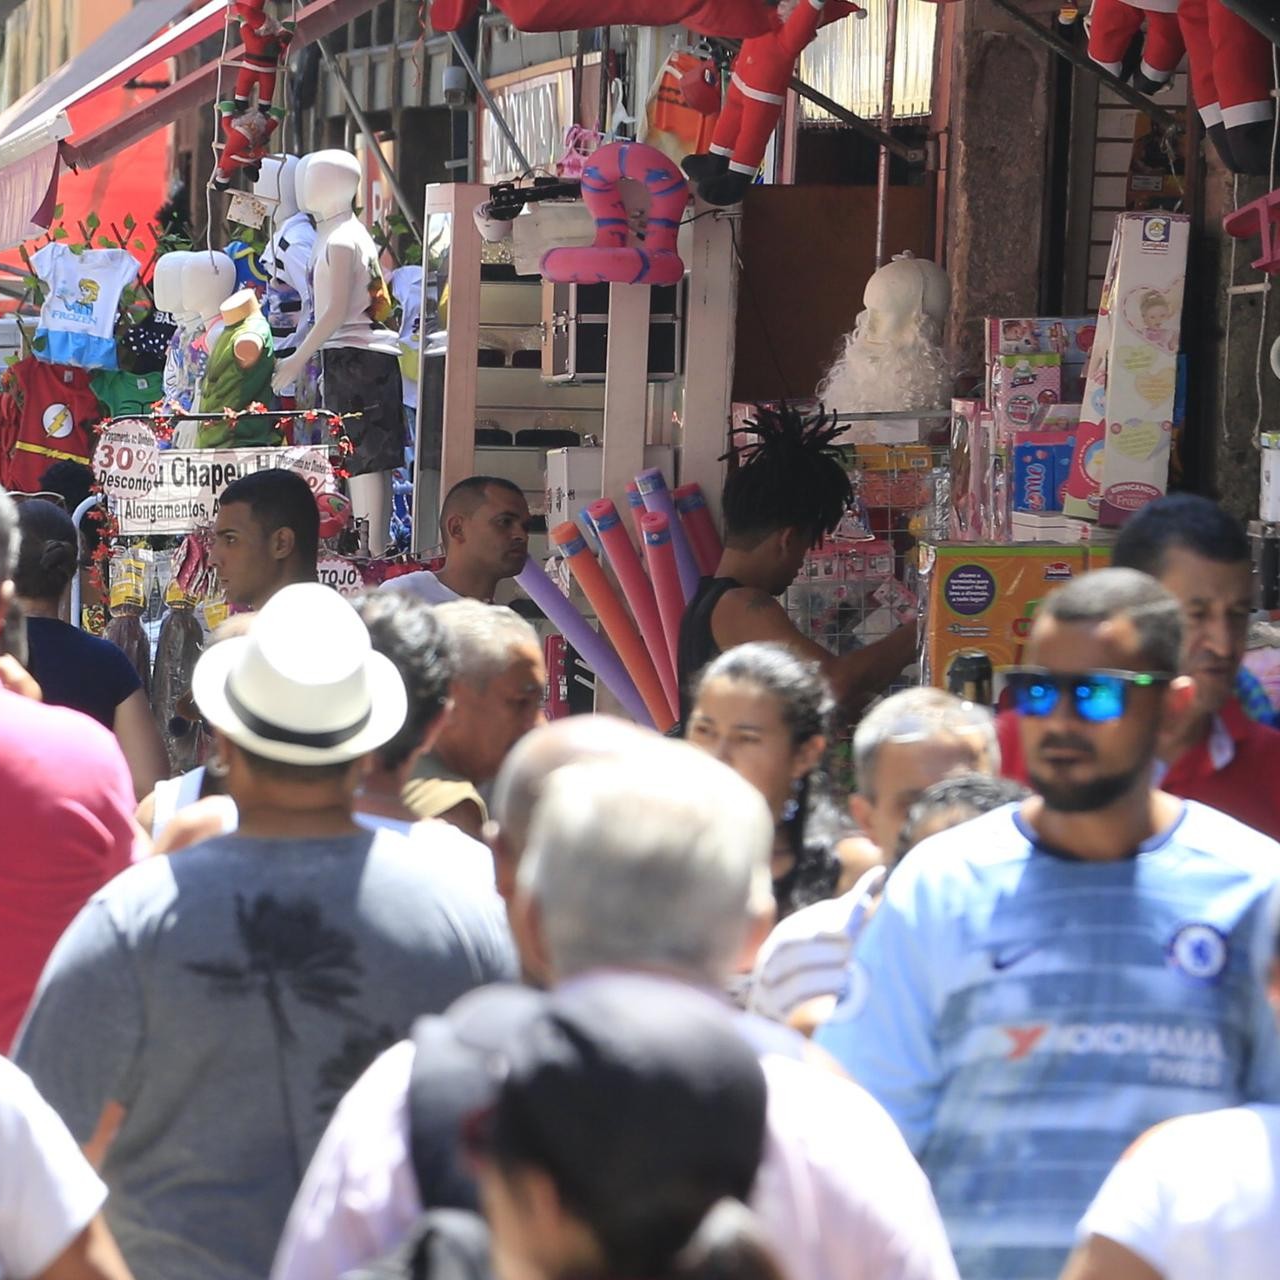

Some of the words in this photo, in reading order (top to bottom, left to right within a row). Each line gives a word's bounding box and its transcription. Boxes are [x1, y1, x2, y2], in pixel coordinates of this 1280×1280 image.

[50, 309, 98, 325] FROZEN
[98, 443, 156, 475] 30%
[98, 469, 153, 493] Desconto
[124, 500, 209, 524] Alongamentos,
[317, 569, 358, 586] TOJO
